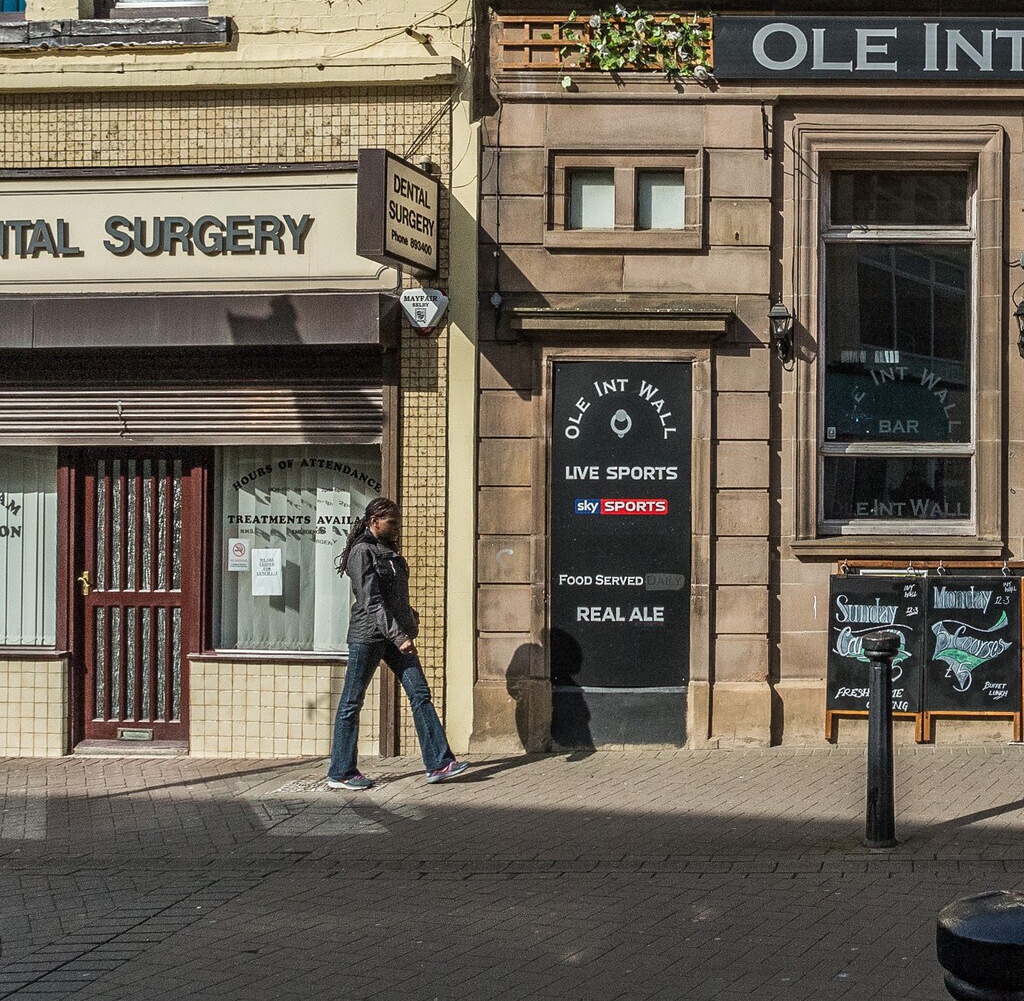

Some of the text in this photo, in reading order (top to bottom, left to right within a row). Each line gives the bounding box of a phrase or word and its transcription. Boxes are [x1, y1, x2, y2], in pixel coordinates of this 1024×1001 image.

[752, 22, 898, 72] OLE
[393, 174, 431, 209] DENTAL
[389, 200, 435, 237] SURGERY
[103, 214, 314, 256] SURGERY
[391, 229, 409, 246] Phone
[565, 379, 676, 440] OLE INT WALL
[870, 367, 961, 433] INT WALL
[879, 420, 919, 433] BAR
[232, 458, 382, 493] HOURS OF ATTENDANCE
[565, 466, 678, 480] LIVE SPORTS
[577, 500, 666, 513] sky SPORTS
[873, 498, 906, 516] INT
[910, 498, 969, 517] WALL
[228, 515, 363, 525] TREATMENTS AVAILA
[559, 574, 592, 586] FOOD
[595, 574, 644, 586] SERVED
[835, 594, 899, 625] Sunday
[933, 586, 993, 614] Monday
[576, 607, 665, 622] REAL ALE
[835, 687, 870, 699] FRESH
